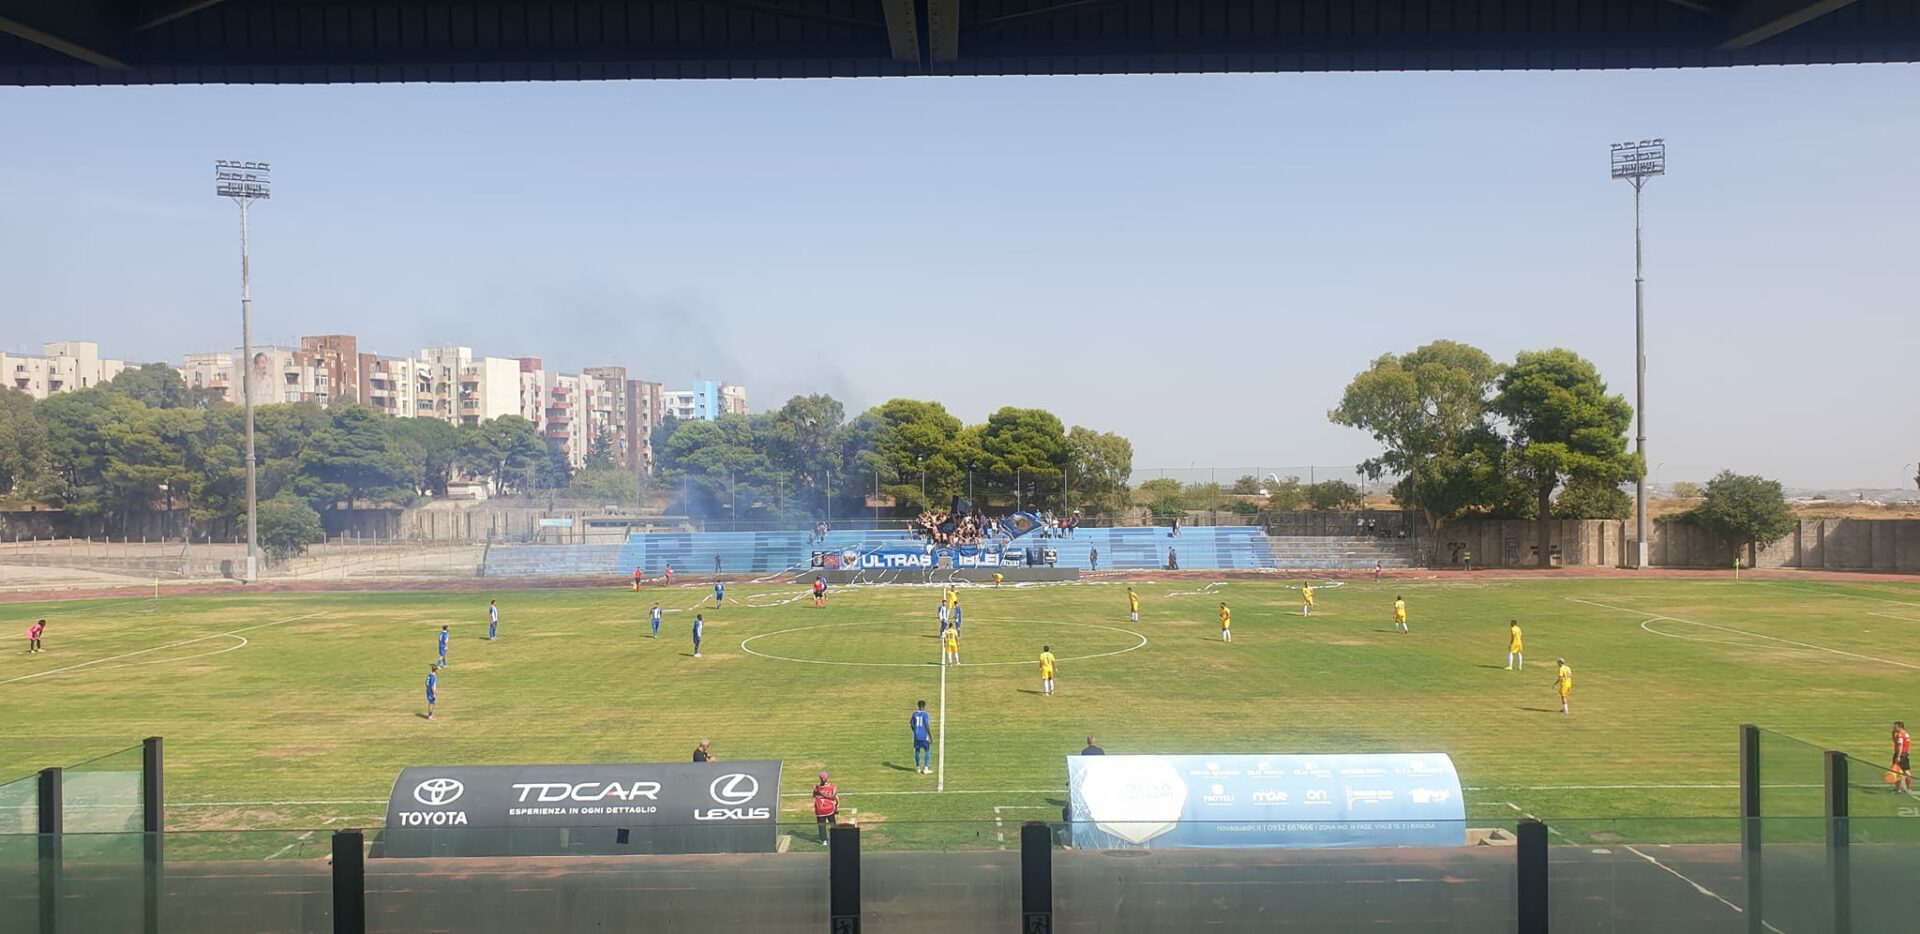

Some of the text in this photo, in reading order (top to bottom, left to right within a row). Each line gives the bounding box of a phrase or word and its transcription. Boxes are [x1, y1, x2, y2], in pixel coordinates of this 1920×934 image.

[862, 554, 932, 567] ULTRAS
[916, 716, 923, 727] 11
[512, 781, 661, 802] TDCAR
[399, 811, 468, 825] TOYOTA
[694, 808, 770, 820] LEXUS
